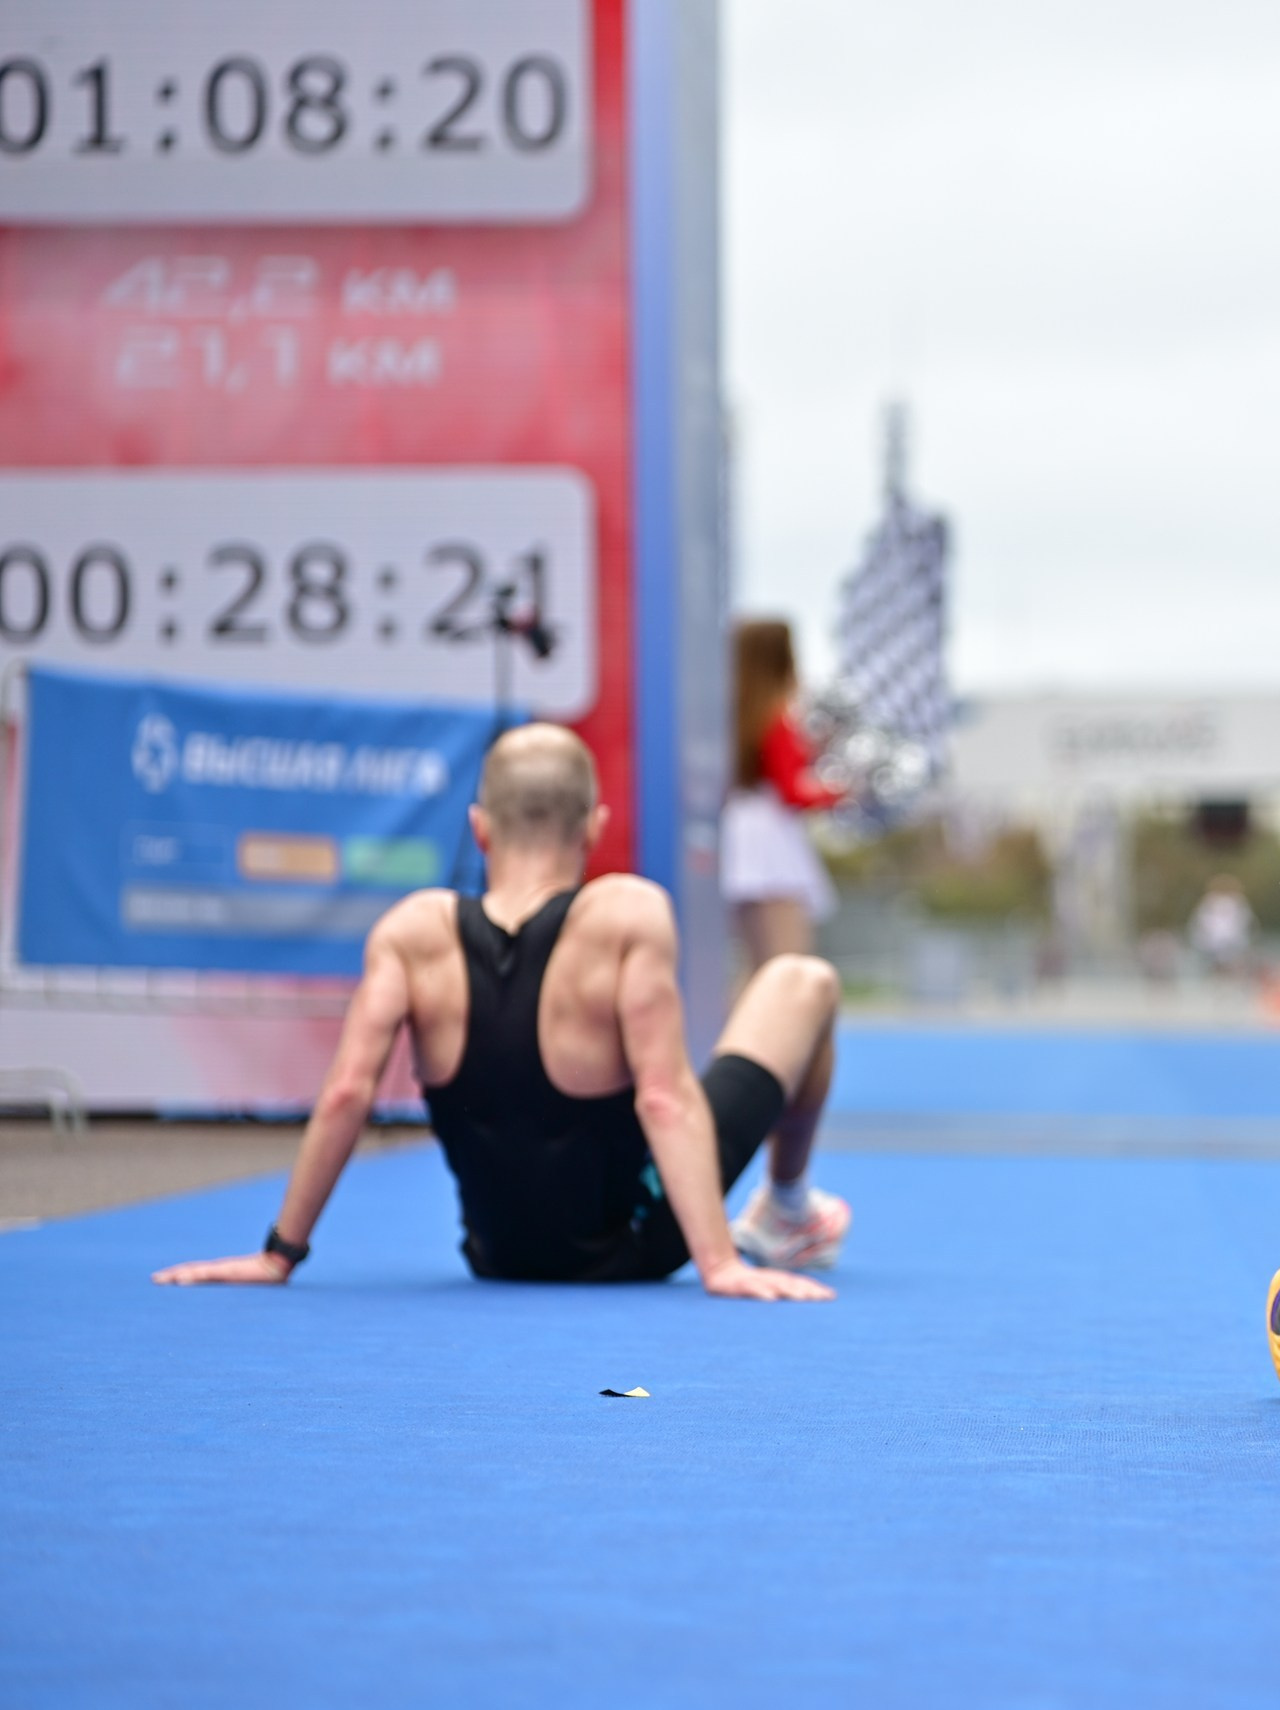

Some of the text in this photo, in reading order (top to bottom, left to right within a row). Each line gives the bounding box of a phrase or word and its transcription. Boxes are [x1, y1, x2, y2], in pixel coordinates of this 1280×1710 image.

[0, 53, 570, 158] 01:08:20
[106, 254, 320, 322] 42,2
[115, 326, 299, 391] 21,1
